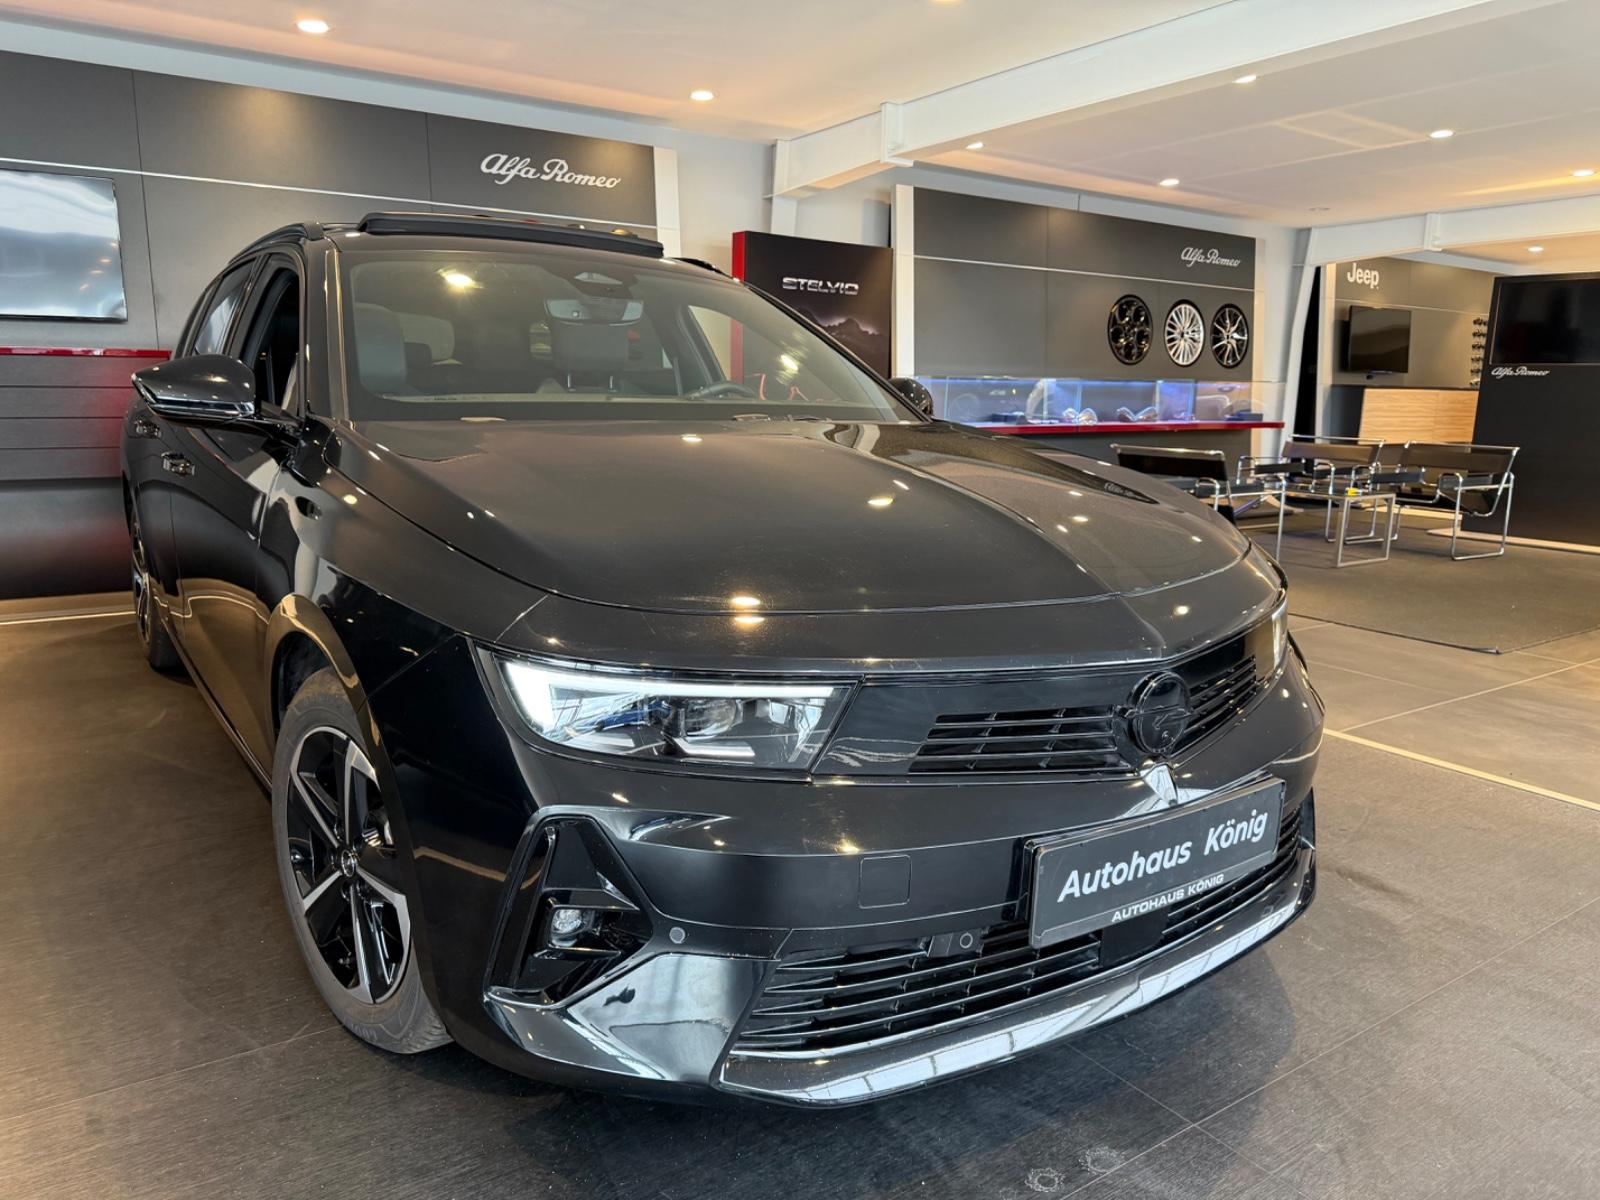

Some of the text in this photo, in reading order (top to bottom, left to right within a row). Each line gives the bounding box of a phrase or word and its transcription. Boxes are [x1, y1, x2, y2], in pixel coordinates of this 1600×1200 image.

[480, 153, 621, 188] Alfa Romeo
[1181, 247, 1241, 267] Alfa Romeo
[782, 276, 860, 296] STELVIO
[1347, 262, 1380, 289] Jeep
[1491, 366, 1550, 379] Alfa Romeo
[1057, 809, 1268, 903] Autohaus König
[1111, 888, 1185, 923] AUTOHAUS
